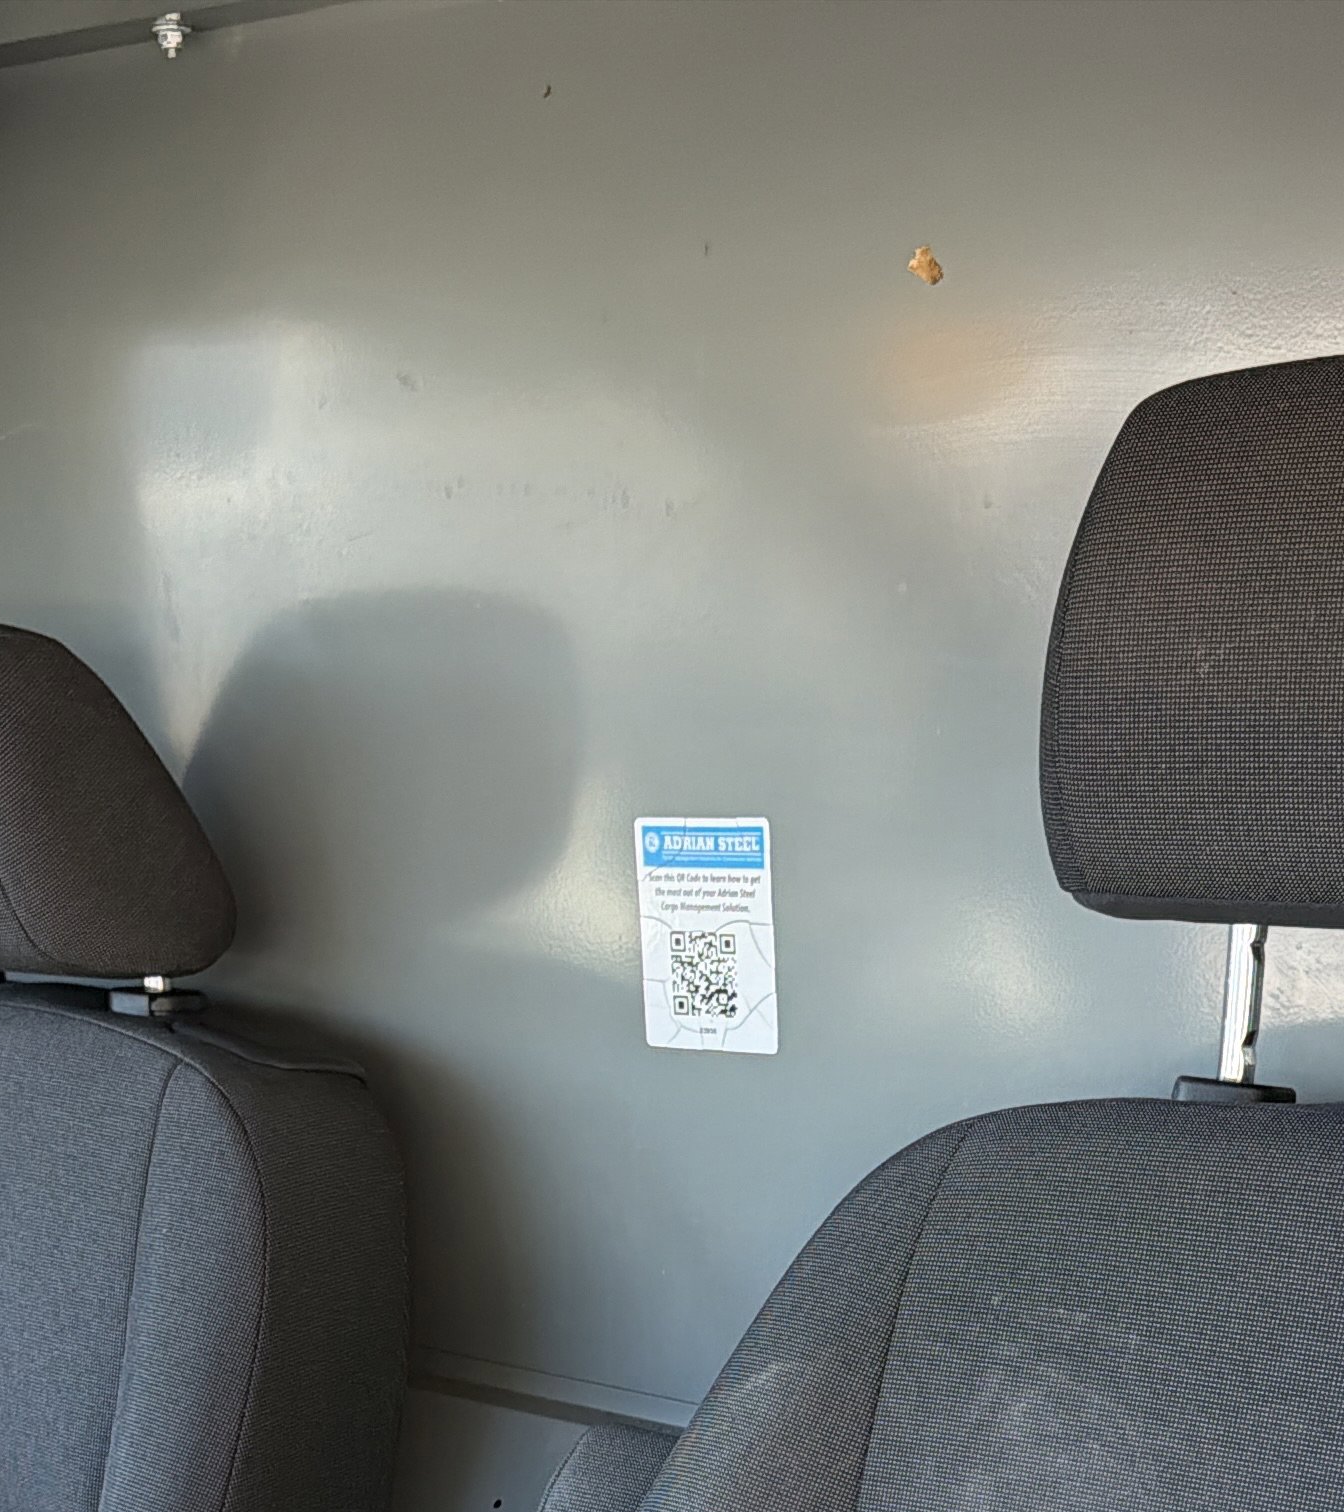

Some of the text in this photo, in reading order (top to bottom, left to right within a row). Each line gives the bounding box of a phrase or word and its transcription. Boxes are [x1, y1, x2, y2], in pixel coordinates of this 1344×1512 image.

[664, 835, 760, 851] ADRIAN STEEL
[676, 874, 685, 883] QR
[687, 873, 701, 882] Code
[727, 874, 741, 882] how
[750, 875, 761, 886] get
[683, 888, 694, 897] out
[695, 887, 702, 897] of
[717, 888, 739, 898] Adrian
[739, 888, 756, 898] Steel
[661, 901, 678, 913] Cargo
[680, 902, 721, 914] Management
